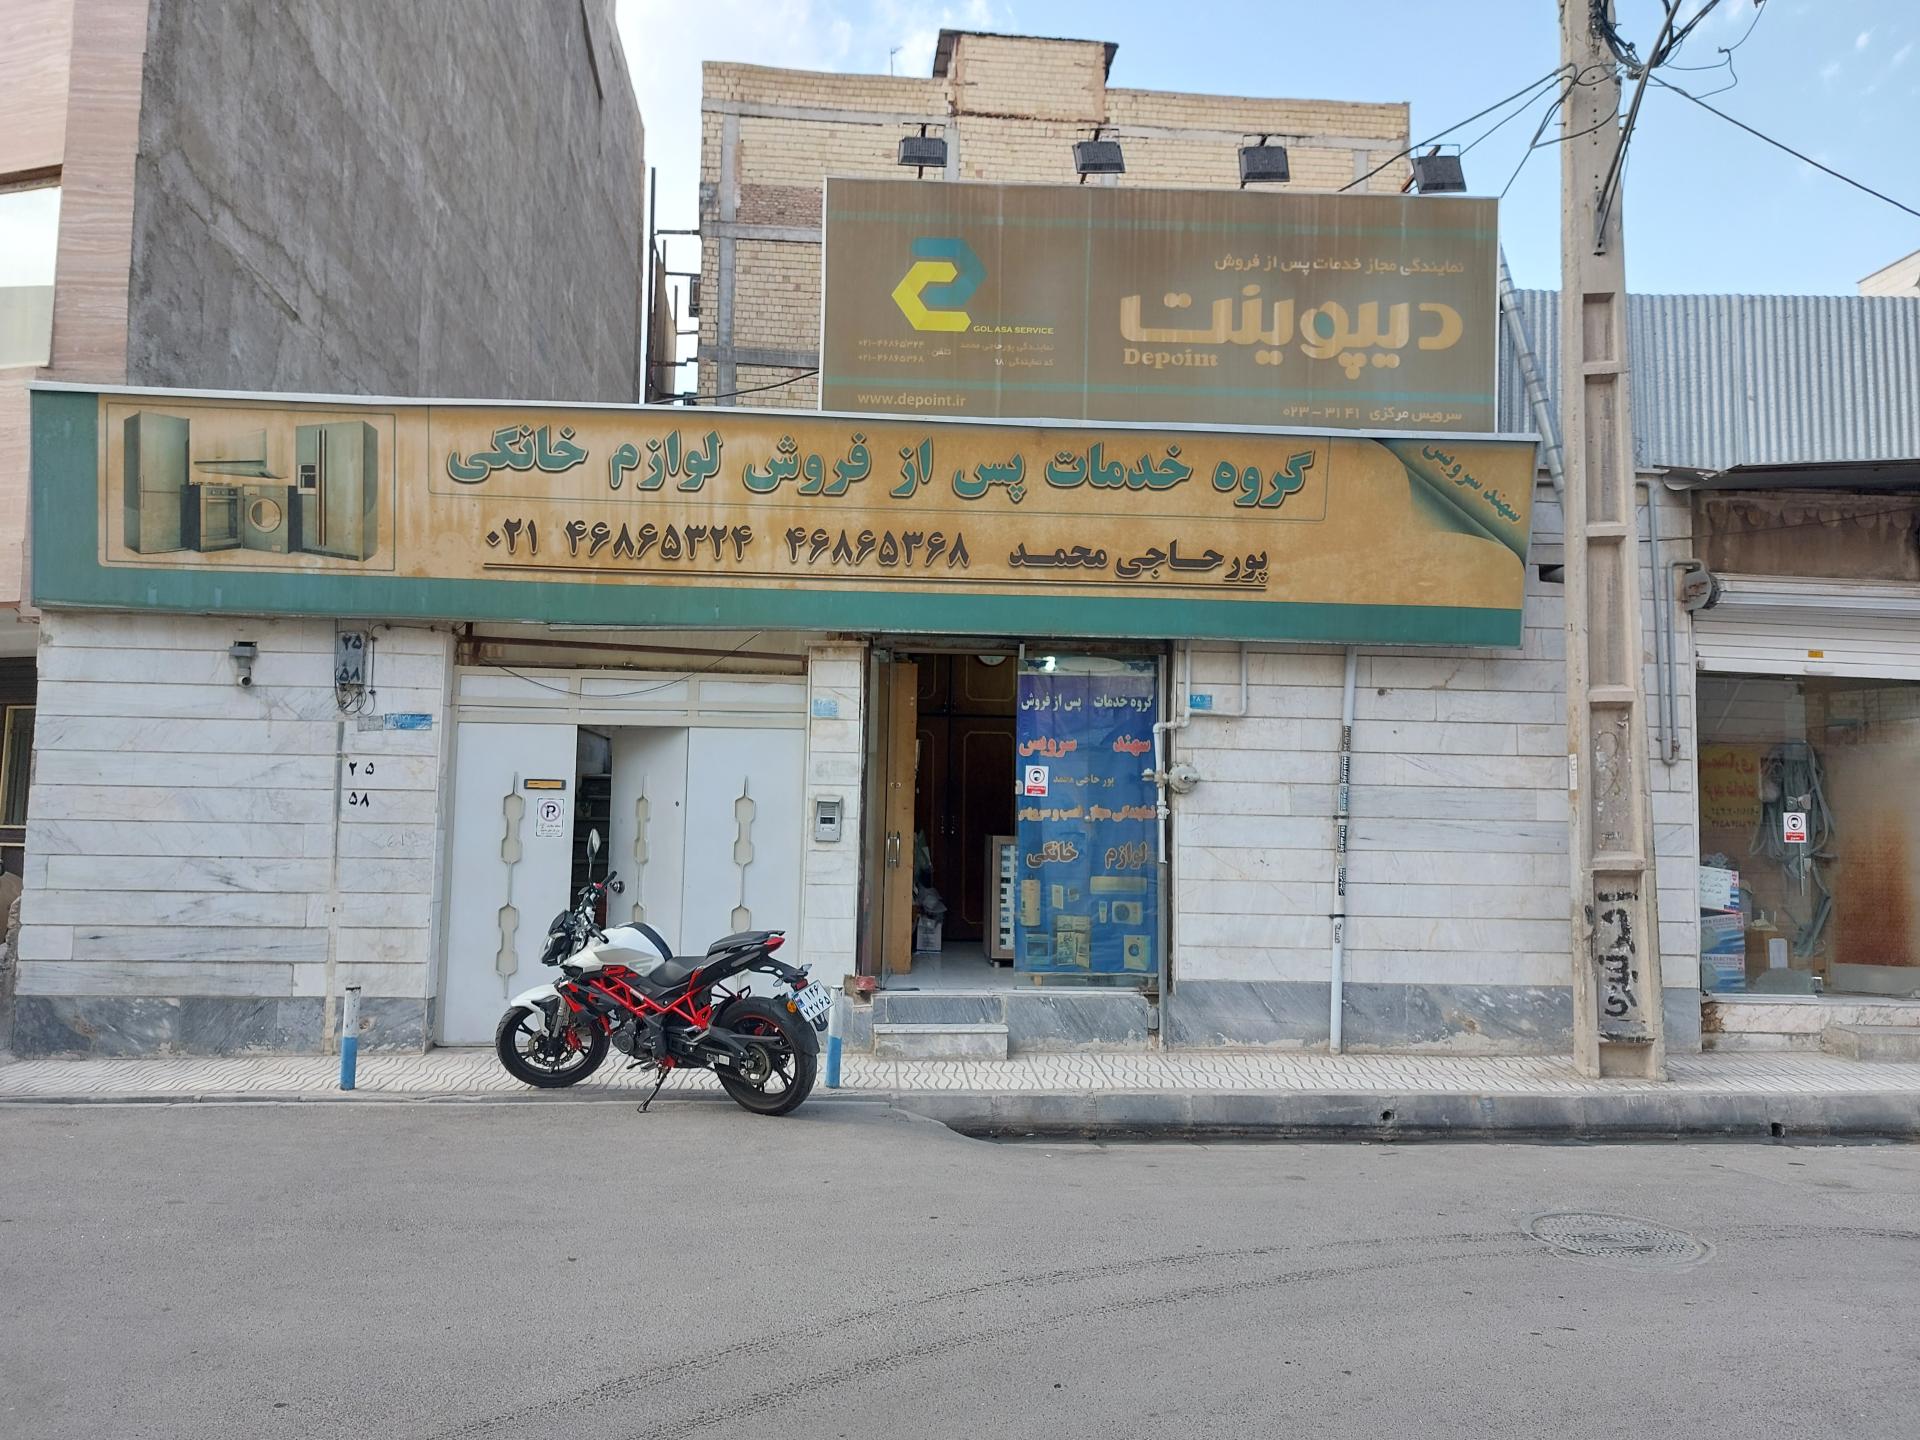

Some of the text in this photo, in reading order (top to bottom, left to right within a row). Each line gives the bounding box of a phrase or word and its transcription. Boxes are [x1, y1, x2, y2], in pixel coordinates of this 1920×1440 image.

[1214, 253, 1464, 276] نمایندگی مجاز خدمات پس از فروش
[973, 325, 993, 333] GOL
[1015, 326, 1055, 335] SERVICE
[1120, 284, 1464, 380] دیپوینت
[1123, 347, 1219, 369] Depoint
[857, 392, 966, 408] www.depoint.ir
[1369, 405, 1409, 422] مرکزی
[1411, 411, 1463, 423] سرویس
[447, 423, 1316, 508] گروه خدمات پس از فروش لوازم خانگی
[1421, 445, 1521, 523] سهند سرویس
[485, 517, 754, 561] ۰۲۱ ۴۶۸۶۵۳۲۴
[785, 526, 971, 568] ۴۶۸۶۵۳۶۸
[1008, 540, 1108, 570] محمد
[342, 633, 363, 650] ۲۵
[338, 667, 361, 684] ۵۸
[1021, 692, 1154, 712] گروه خدمات پس از فروش
[1019, 734, 1152, 758] سهند سرویس
[348, 791, 370, 807] ۵۸
[1026, 840, 1148, 870] لوازم خانگی
[804, 984, 819, 1001] ۱۴۶
